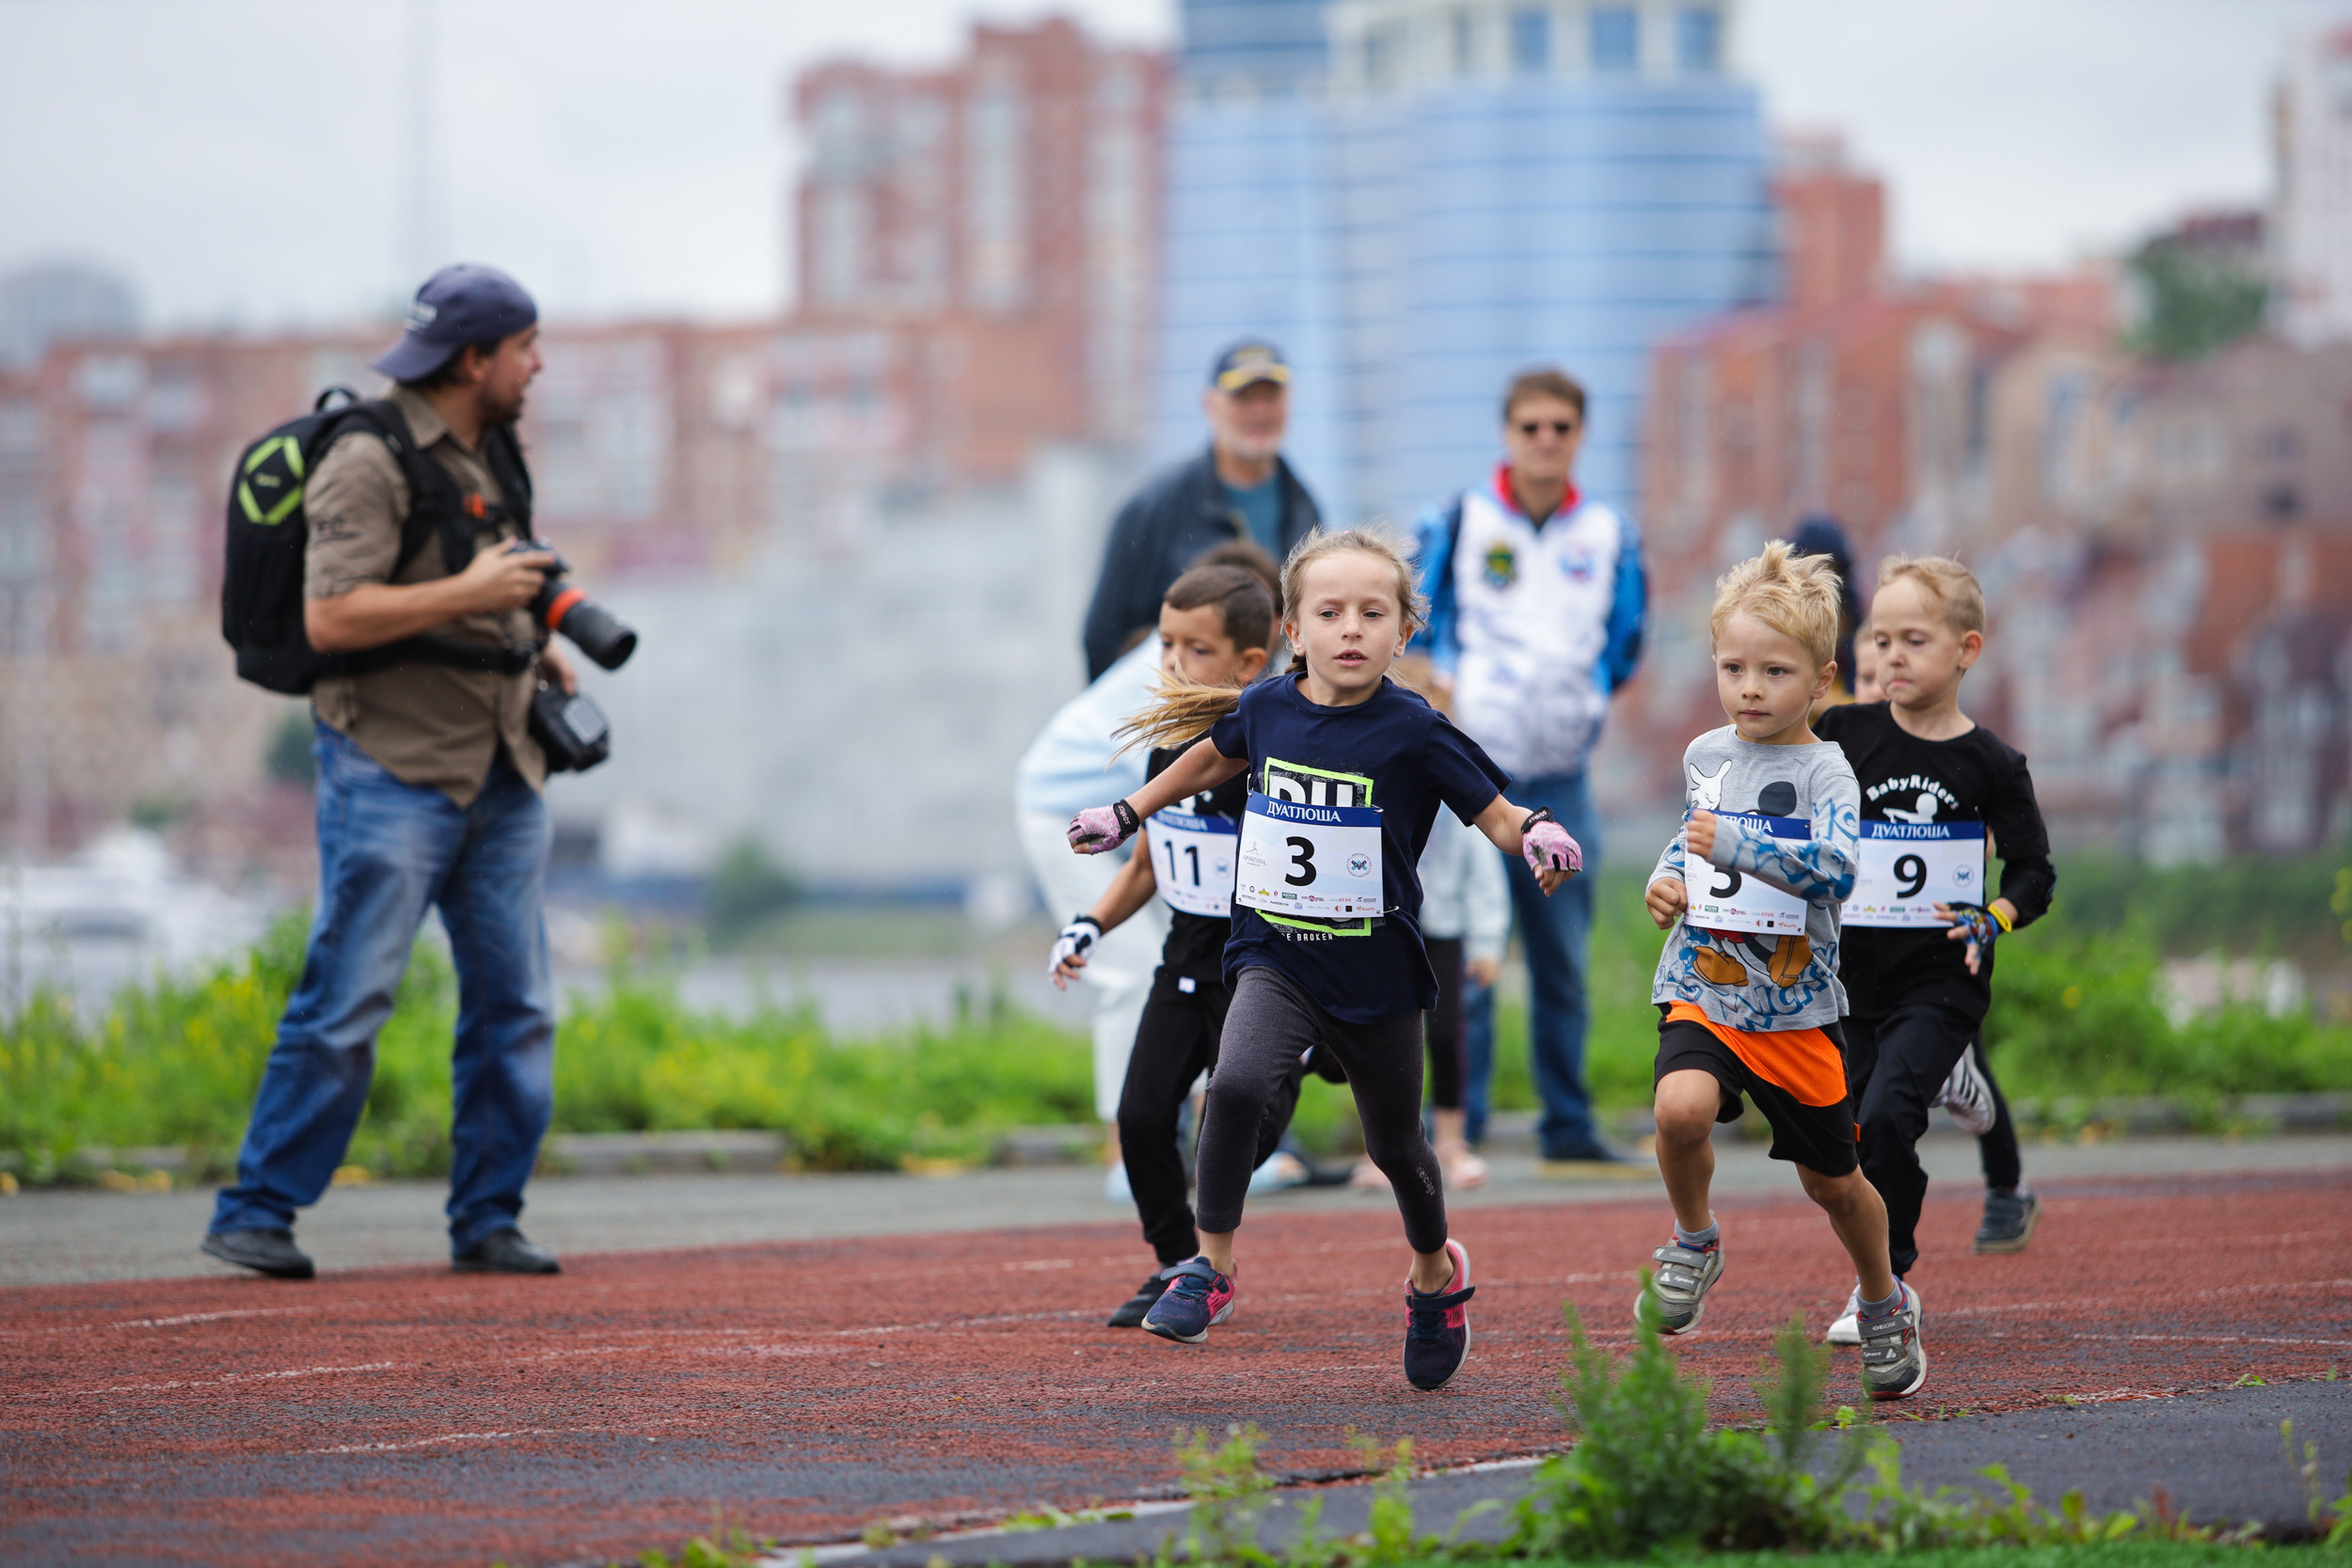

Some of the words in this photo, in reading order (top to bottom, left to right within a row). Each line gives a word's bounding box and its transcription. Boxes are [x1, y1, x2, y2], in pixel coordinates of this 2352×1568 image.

[1866, 774, 1960, 811] BabyRiders
[1266, 800, 1343, 823] ДУАТЛОША
[1871, 823, 1951, 839] ДУАТЛОША
[1165, 840, 1200, 886] 11
[1284, 835, 1317, 887] 3
[1893, 853, 1928, 900] 9
[1296, 932, 1333, 942] BROKEN
[1669, 1251, 1692, 1259] GEOX
[1872, 1321, 1897, 1331] GEOX
